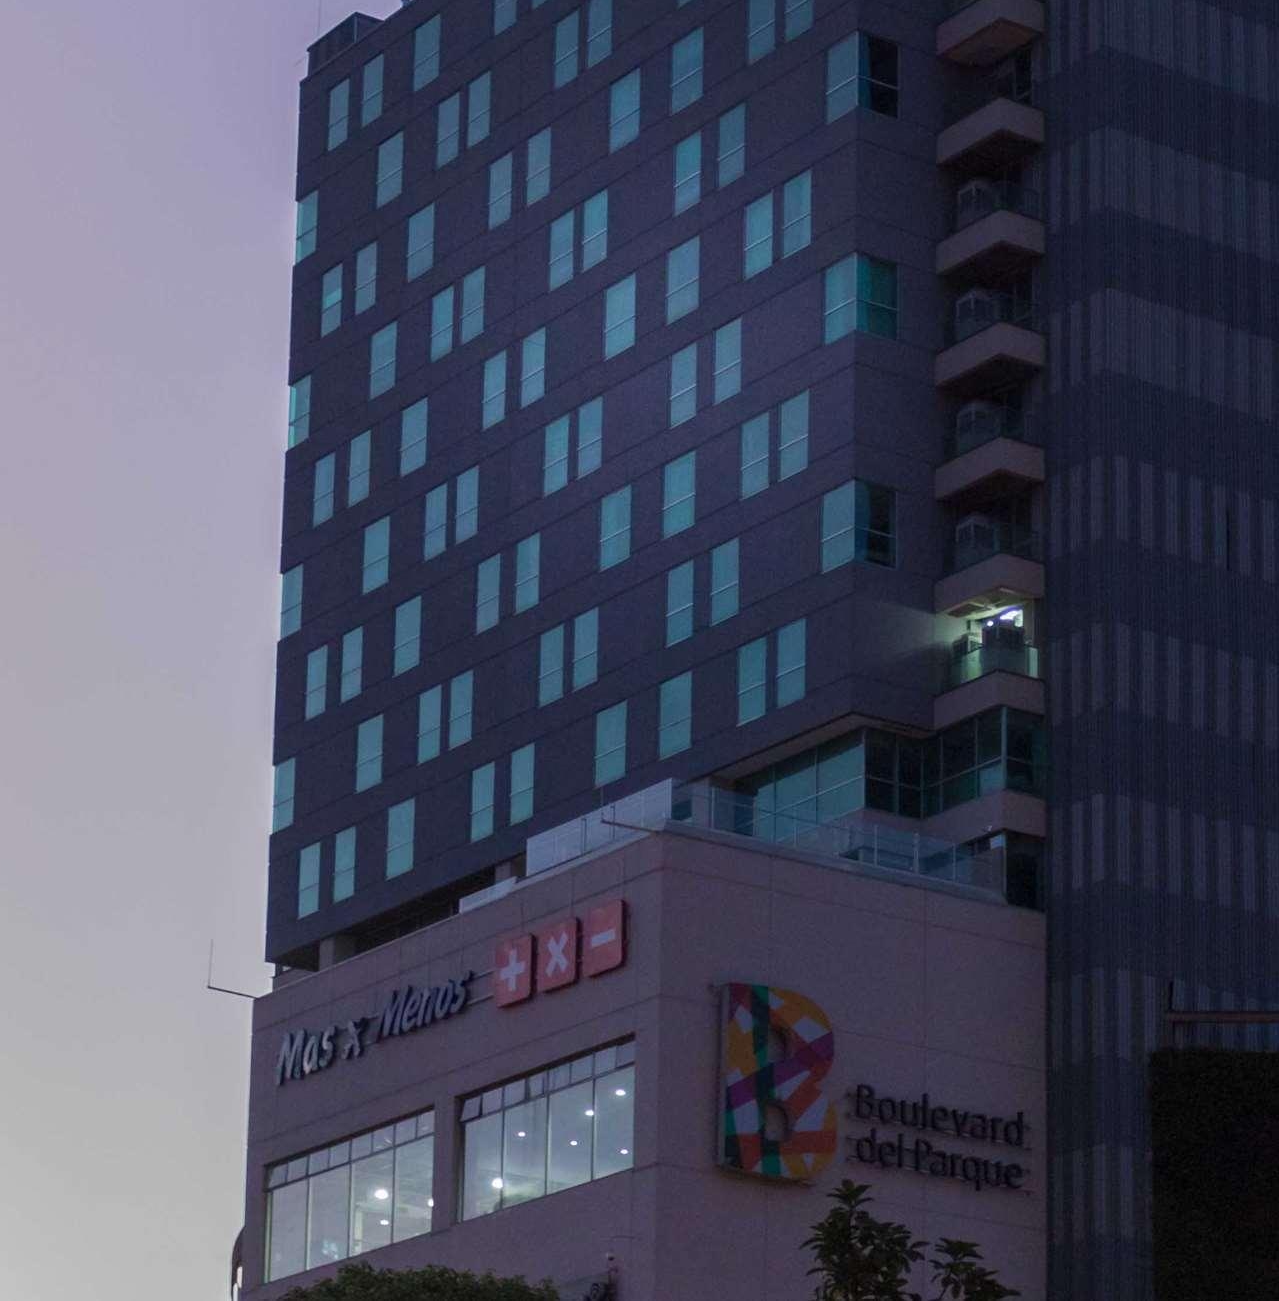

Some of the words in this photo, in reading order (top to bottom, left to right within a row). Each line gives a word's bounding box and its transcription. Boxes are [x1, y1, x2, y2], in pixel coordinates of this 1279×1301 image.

[276, 1026, 337, 1086] Mas
[376, 969, 474, 1041] Menos
[716, 982, 838, 1181] B
[854, 1083, 1025, 1146] Boulevard
[854, 1129, 904, 1170] del
[913, 1138, 1023, 1191] Parque
